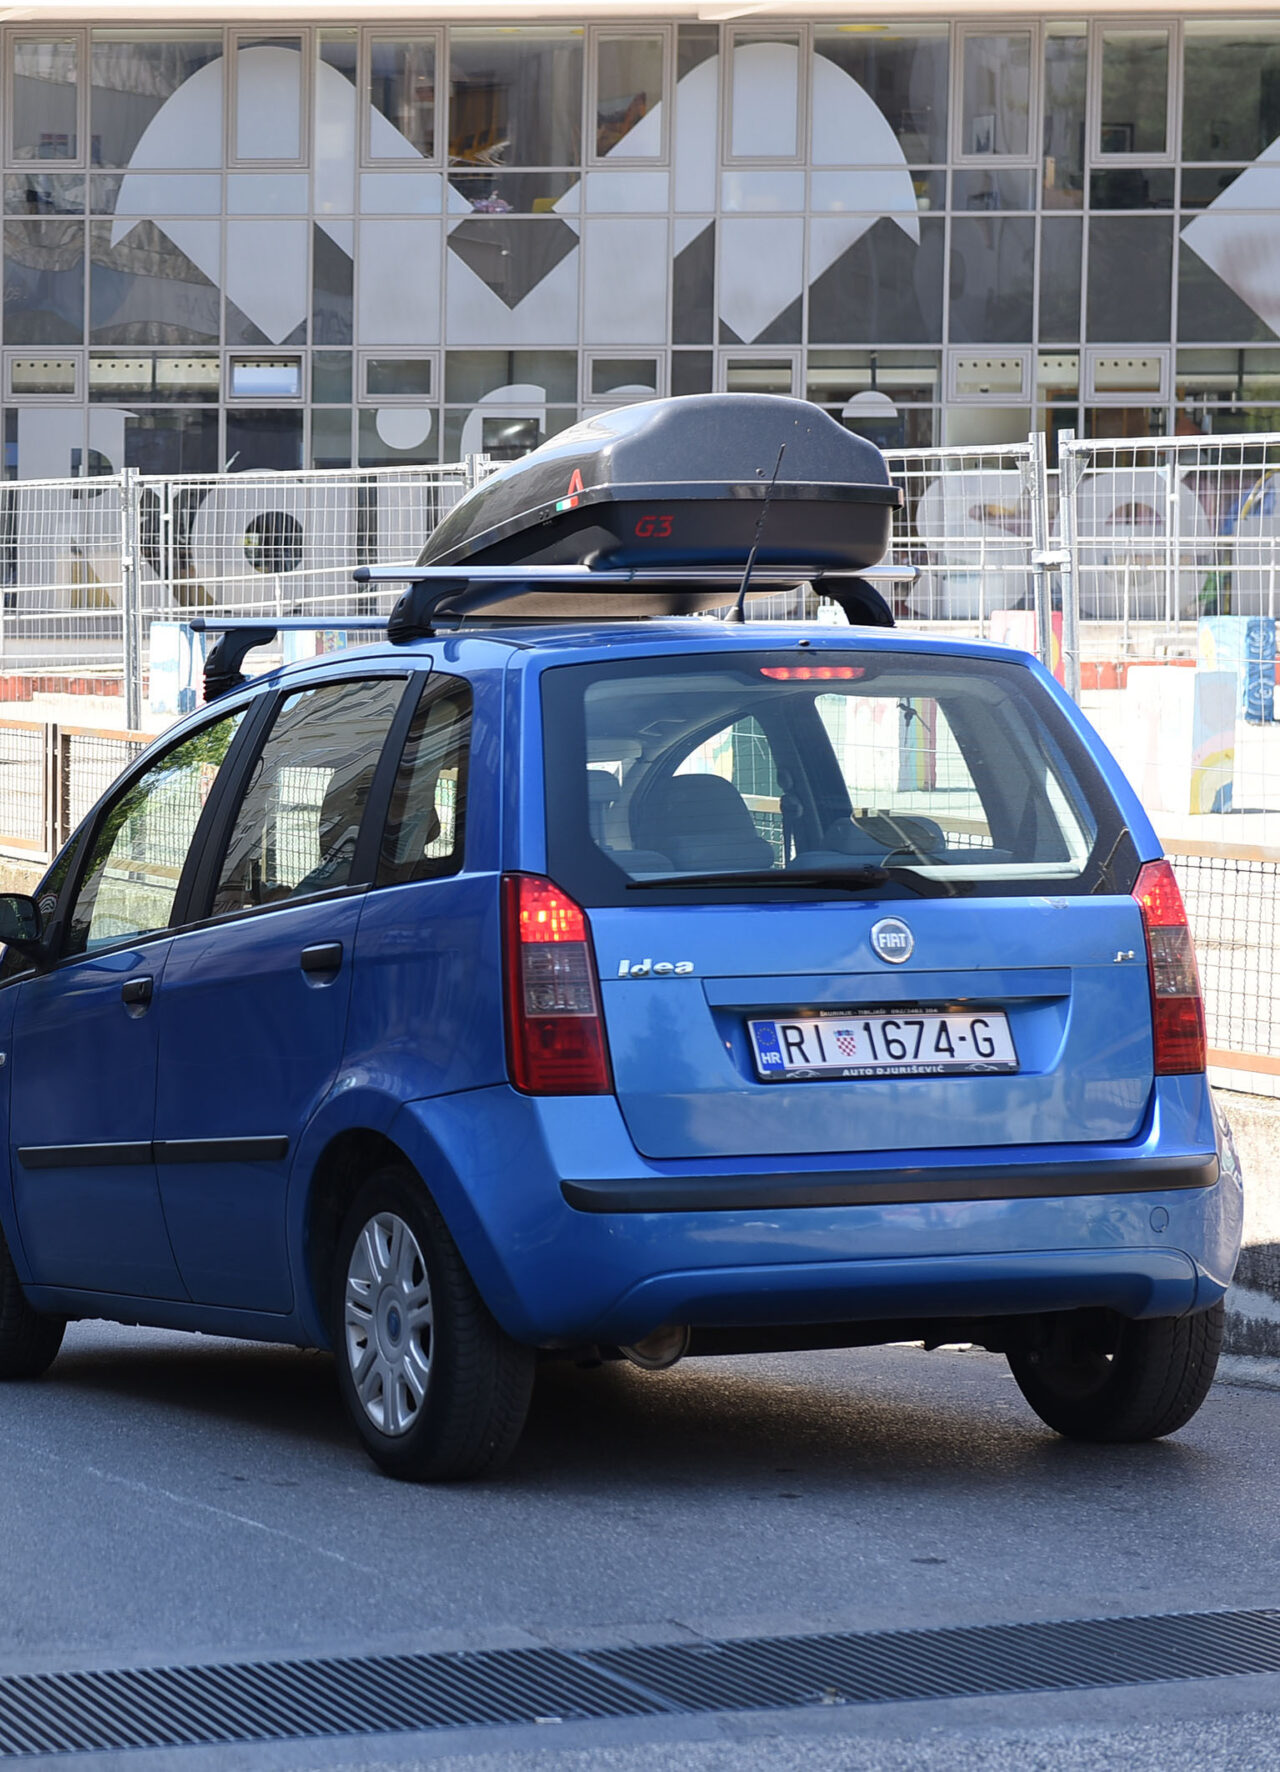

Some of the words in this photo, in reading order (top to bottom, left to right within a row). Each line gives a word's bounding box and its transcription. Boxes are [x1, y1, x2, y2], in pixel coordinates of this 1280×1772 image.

[635, 515, 674, 537] G3
[878, 932, 907, 948] FIAT
[617, 958, 695, 978] Idea
[780, 1024, 827, 1064] RI
[862, 1018, 996, 1061] 1674-G
[760, 1052, 782, 1065] HR
[842, 1067, 874, 1077] AUTO
